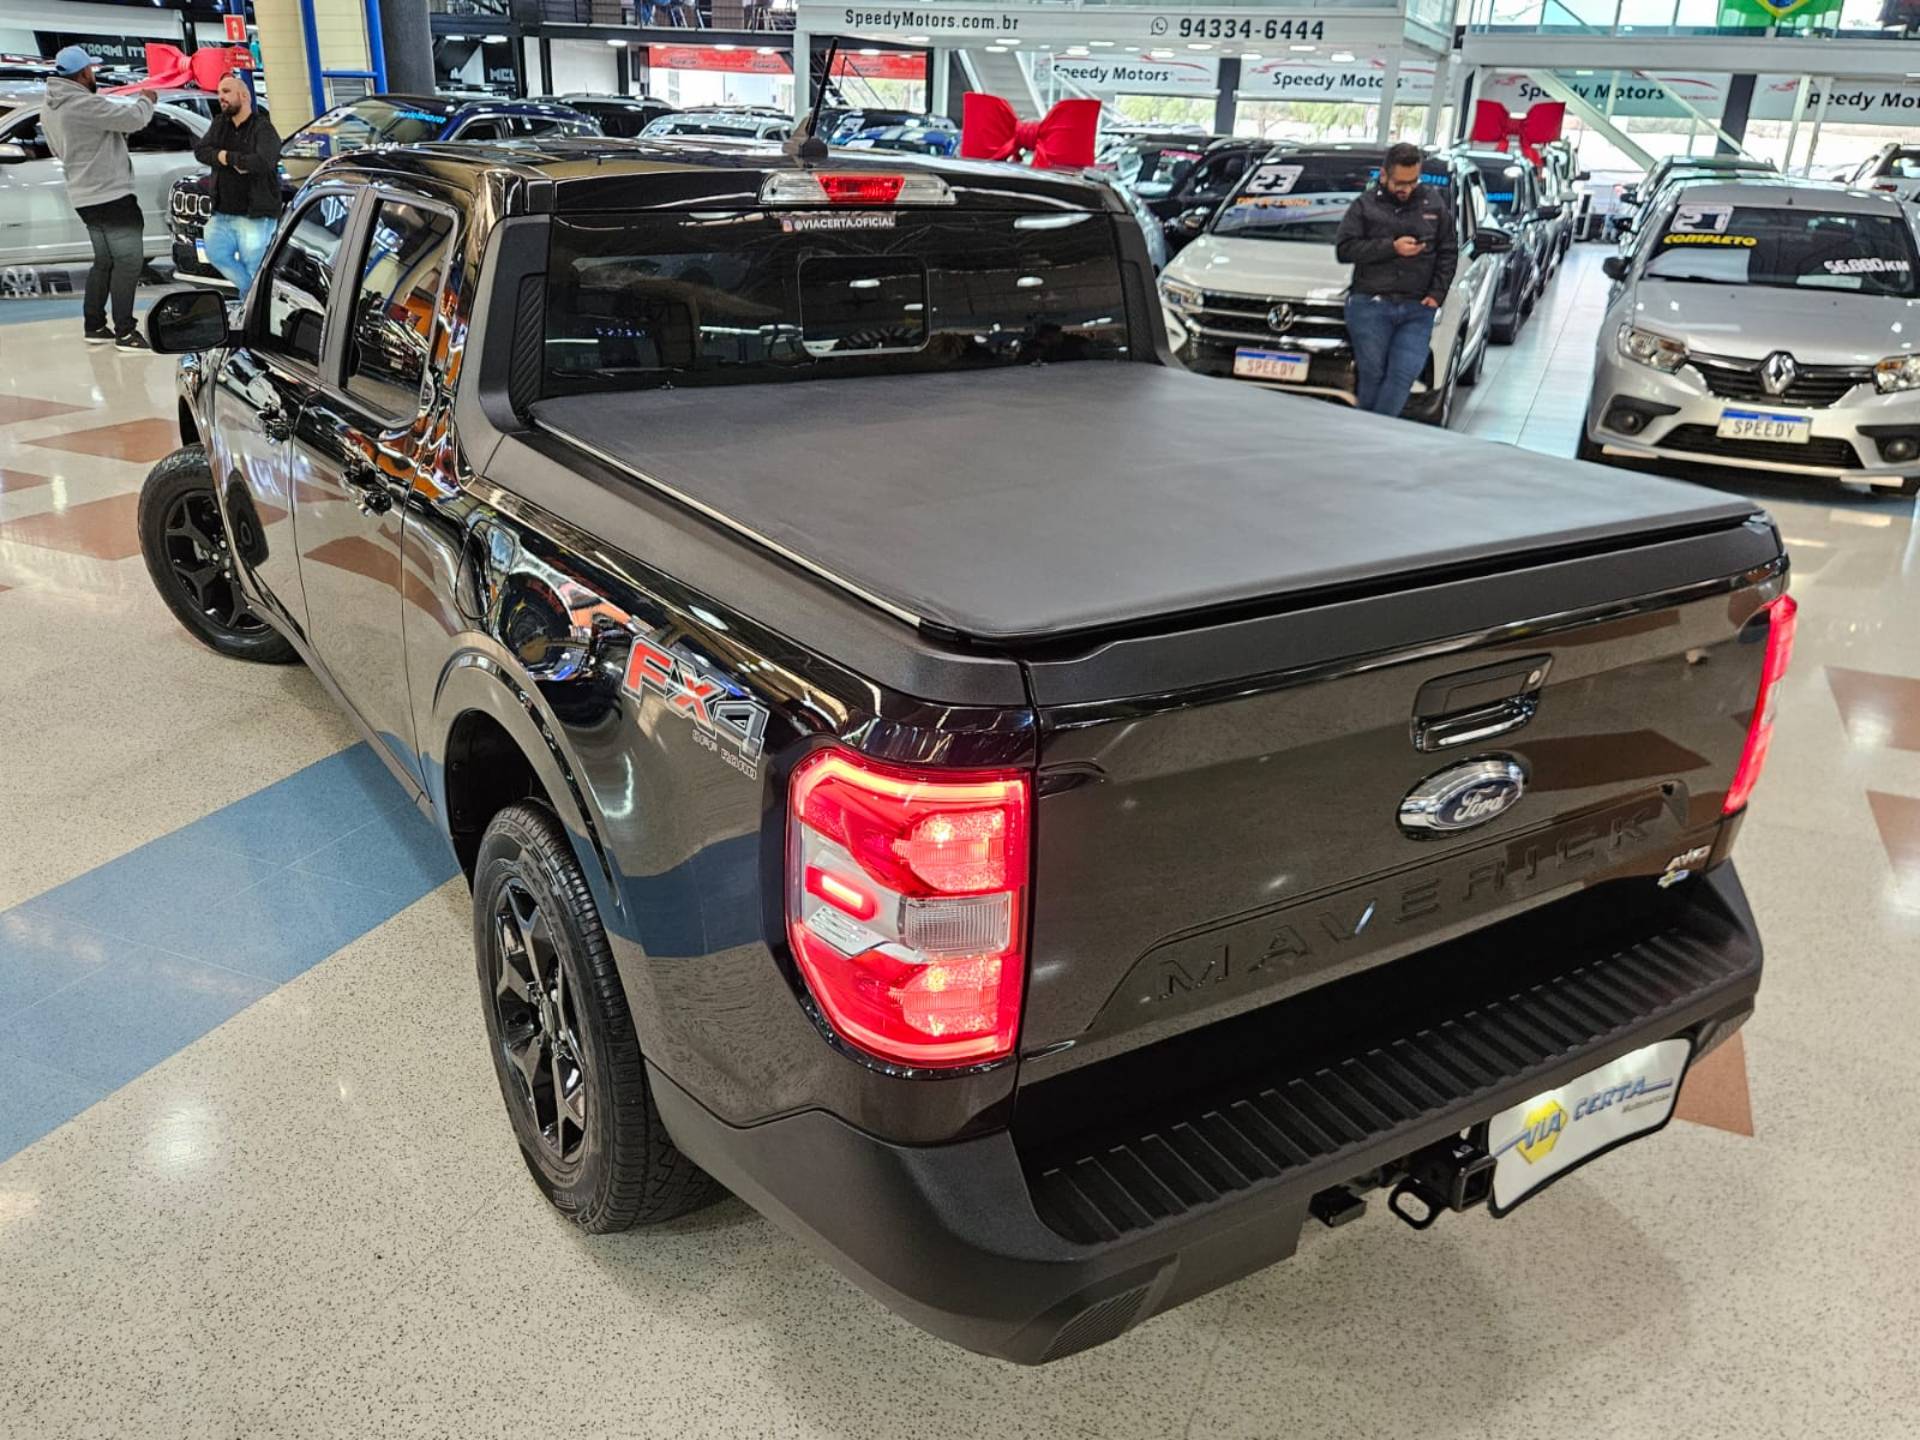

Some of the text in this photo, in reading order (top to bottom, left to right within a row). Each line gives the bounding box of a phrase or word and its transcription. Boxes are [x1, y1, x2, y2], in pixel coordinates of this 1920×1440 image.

[845, 8, 1019, 31] SpeedyMotors.com.br
[1178, 18, 1325, 41] 94334-6444
[1112, 67, 1169, 81] Motors
[1273, 71, 1403, 91] Speedy Motos
[1518, 83, 1665, 102] Spy Motors
[1806, 91, 1877, 112] pedy
[794, 216, 896, 231] @VIACERTA.OFICIAL
[1663, 233, 1758, 247] COMPLETO
[1733, 420, 1796, 438] SPEEDY
[621, 635, 770, 767] FX4
[1453, 784, 1511, 822] Ford
[1155, 808, 1652, 1003] MAVERICK
[1521, 1106, 1563, 1150] VIA
[1573, 1075, 1648, 1122] CERTA
